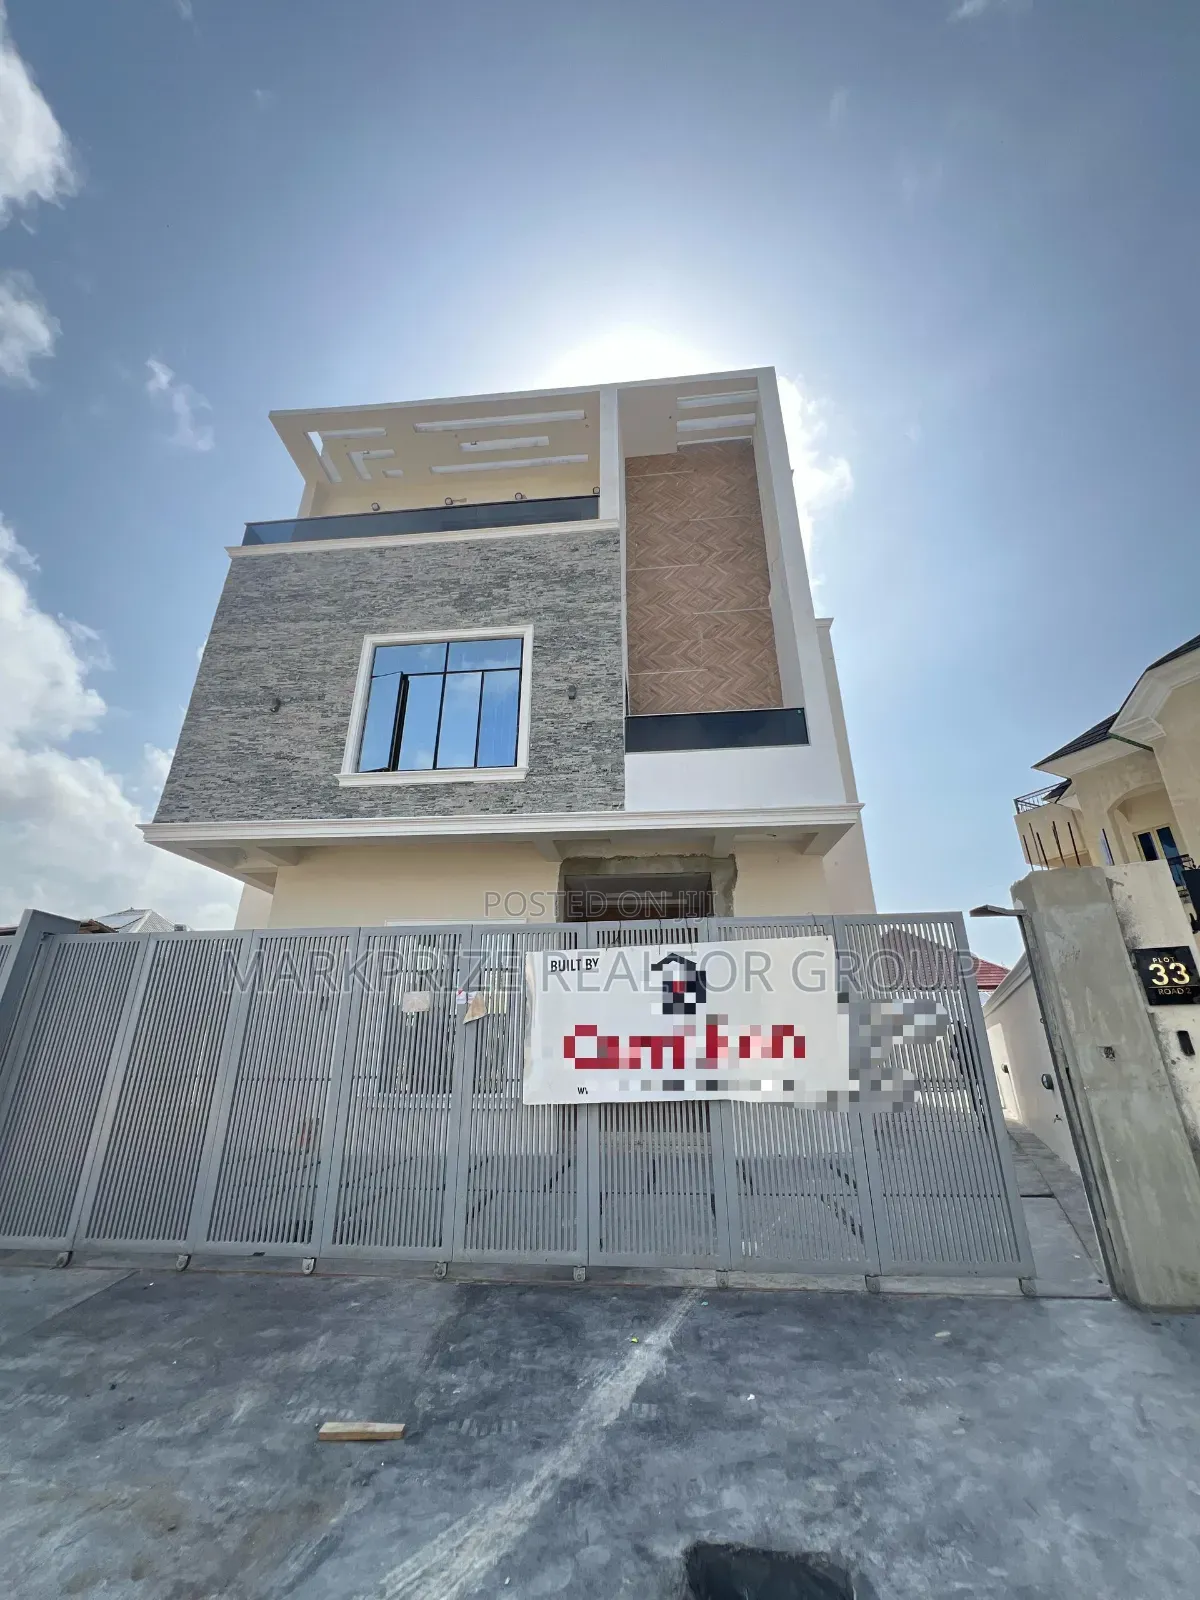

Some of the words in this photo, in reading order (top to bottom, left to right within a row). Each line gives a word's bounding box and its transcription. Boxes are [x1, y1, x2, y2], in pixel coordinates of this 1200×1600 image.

[550, 958, 582, 972] BUILT
[585, 957, 599, 971] BY
[1149, 962, 1190, 985] 33
